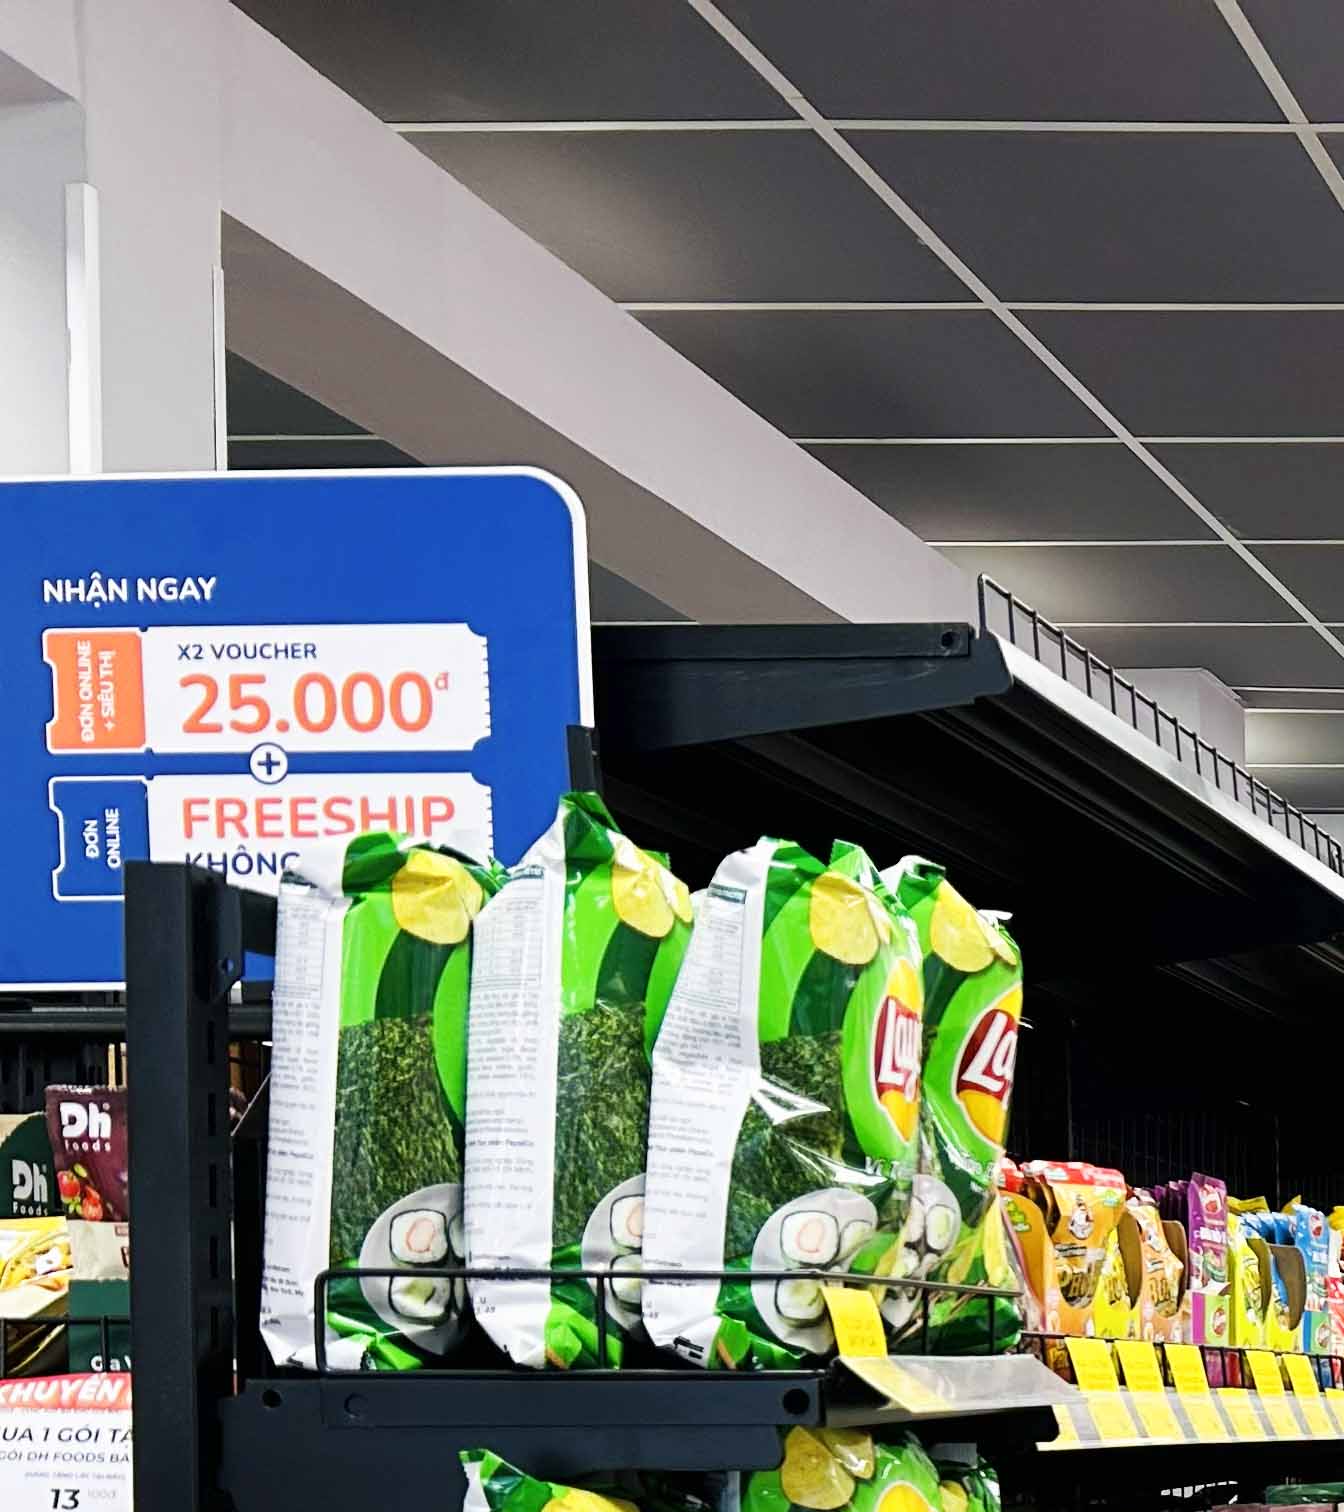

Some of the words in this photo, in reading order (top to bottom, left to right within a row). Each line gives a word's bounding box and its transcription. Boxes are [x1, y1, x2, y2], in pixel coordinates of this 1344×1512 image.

[42, 572, 128, 607] NHẬN
[137, 576, 216, 603] NGAY
[79, 640, 93, 696] ONLINE
[177, 643, 204, 660] X2
[213, 642, 318, 660] VOUCHER
[80, 698, 95, 743] ĐƠN
[182, 795, 456, 840] FREESHIP
[85, 818, 98, 860] ĐƠN
[106, 807, 119, 869] ONLINE
[59, 1101, 113, 1139] Dh
[11, 1159, 49, 1203] Dh
[0, 1426, 34, 1442] UA
[27, 1451, 49, 1461] DH
[53, 1452, 105, 1463] FOODS
[50, 1488, 80, 1510] 13
